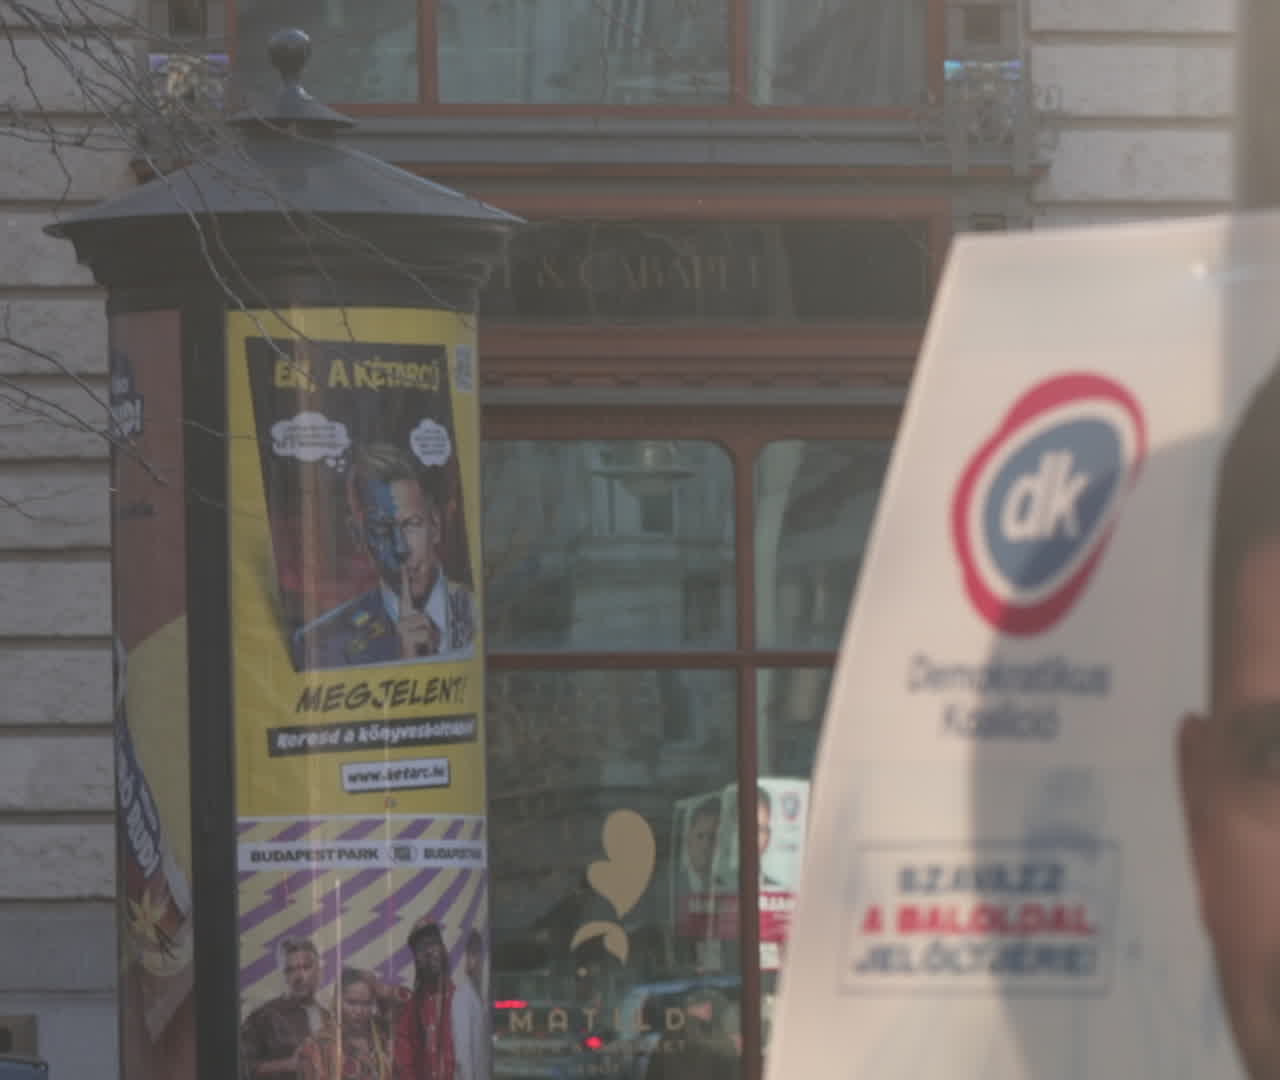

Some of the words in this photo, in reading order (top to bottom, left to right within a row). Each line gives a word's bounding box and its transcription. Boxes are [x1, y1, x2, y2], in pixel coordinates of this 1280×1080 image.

[327, 360, 349, 388] A
[1002, 451, 1089, 542] dk
[250, 849, 332, 863] BUDAPEST
[337, 848, 379, 861] PARK
[859, 902, 885, 937] A
